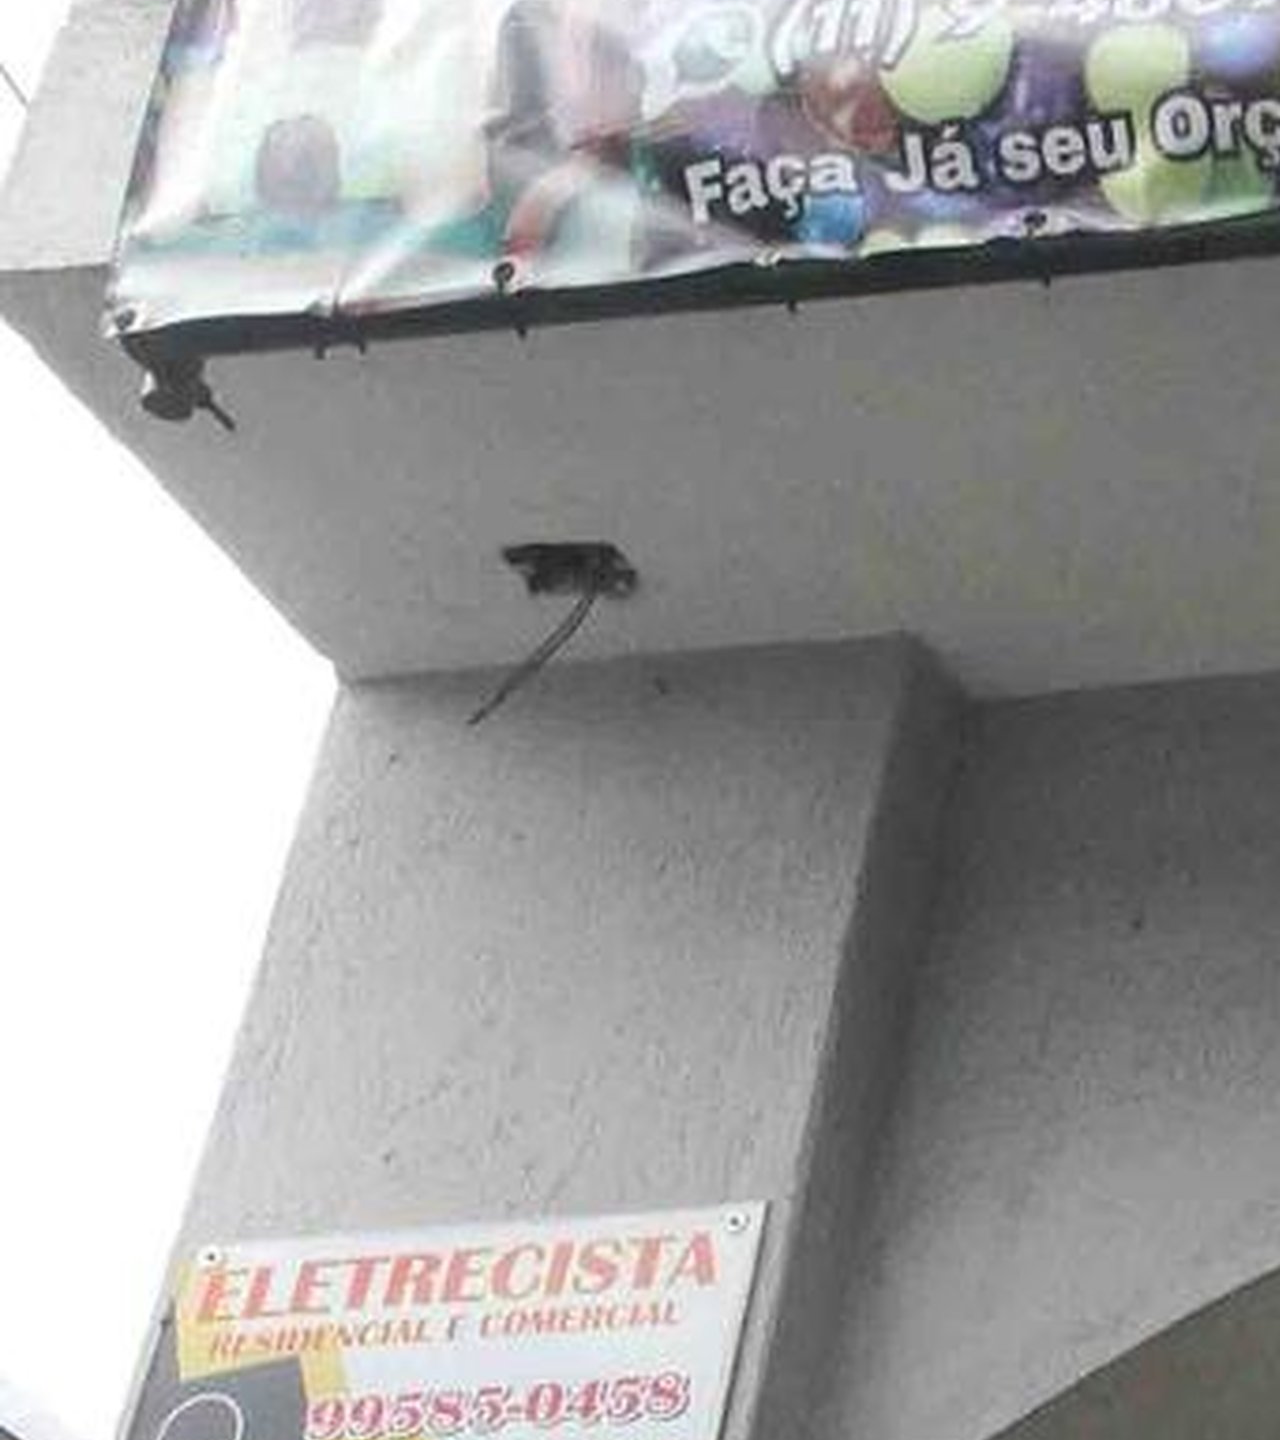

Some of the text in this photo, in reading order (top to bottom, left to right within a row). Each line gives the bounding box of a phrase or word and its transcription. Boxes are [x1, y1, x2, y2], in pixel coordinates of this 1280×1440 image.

[683, 150, 857, 224] Faça
[884, 122, 980, 194] Já
[999, 112, 1136, 183] seu
[194, 1230, 719, 1324] ELETRECISTA
[207, 1313, 434, 1360] RESIDENCIAL
[479, 1299, 681, 1341] COMERCIAL
